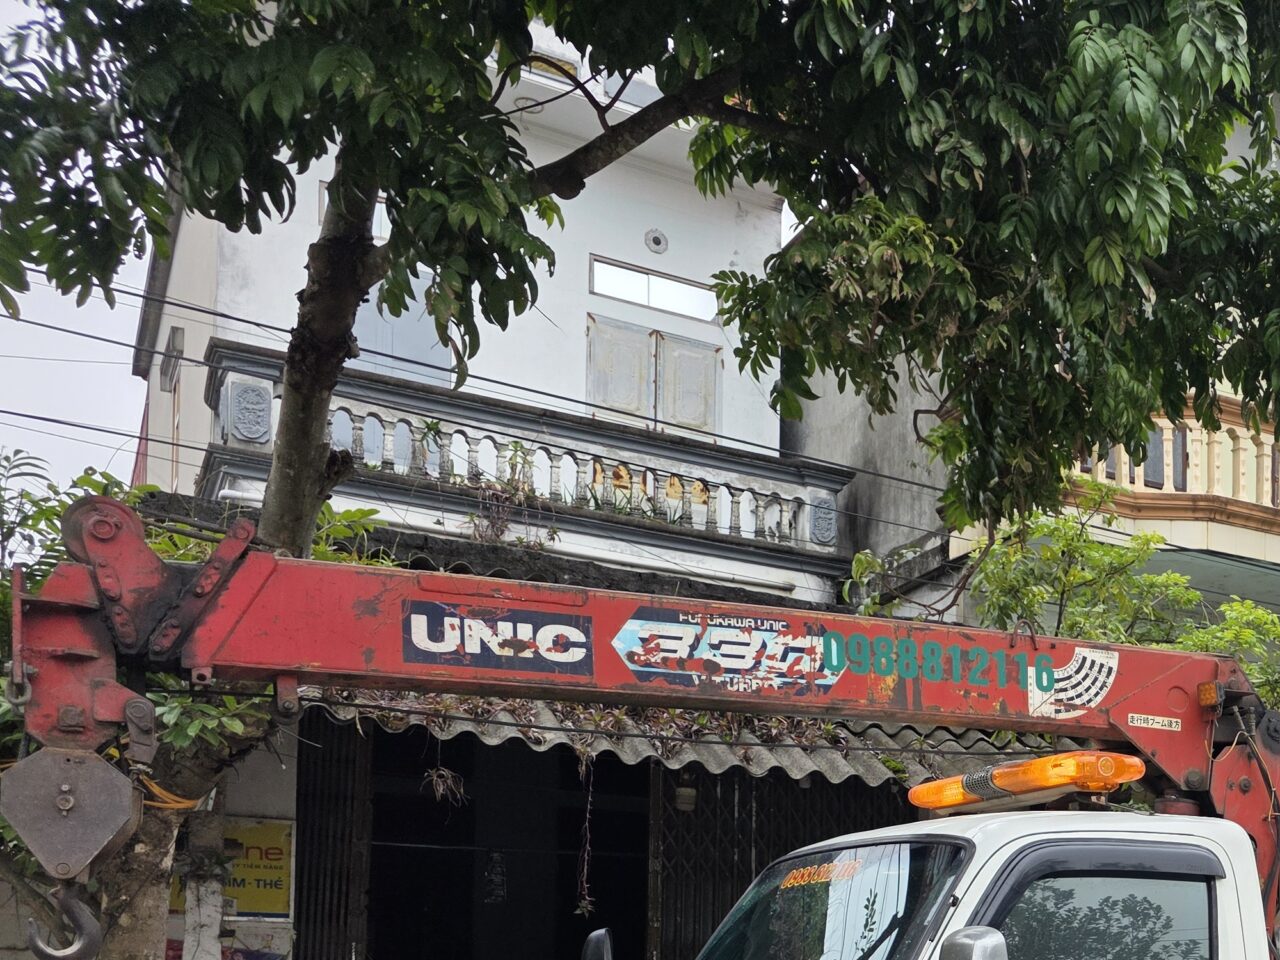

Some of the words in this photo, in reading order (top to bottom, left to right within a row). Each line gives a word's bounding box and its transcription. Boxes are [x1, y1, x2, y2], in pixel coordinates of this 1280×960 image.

[411, 614, 587, 662] UNIC
[758, 620, 787, 631] UNIC
[823, 632, 1055, 693] 0988812116
[1129, 715, 1180, 730] 走行時ブーム後方
